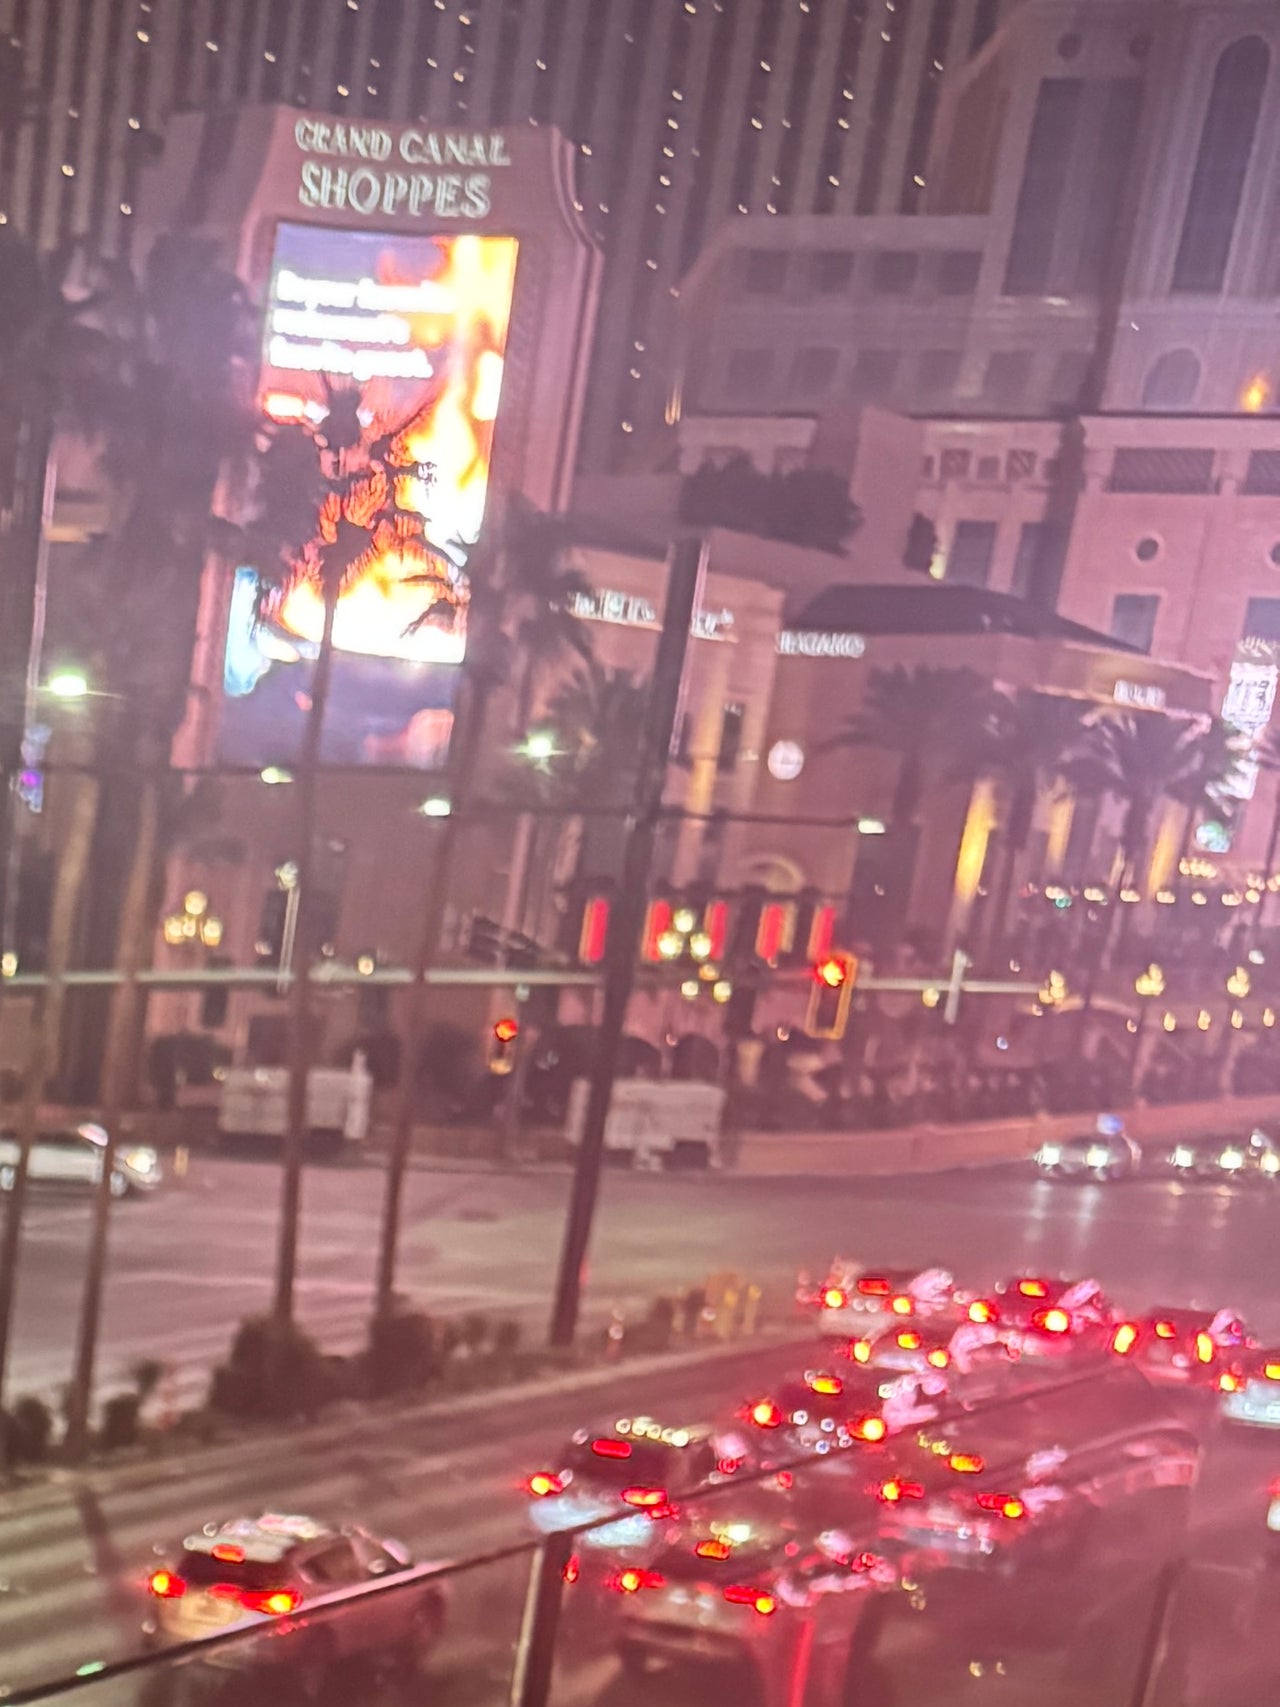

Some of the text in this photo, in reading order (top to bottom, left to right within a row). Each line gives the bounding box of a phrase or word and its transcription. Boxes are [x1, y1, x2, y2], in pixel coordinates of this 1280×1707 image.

[294, 116, 512, 167] GRAND CANAL
[298, 159, 491, 219] SHOPPES
